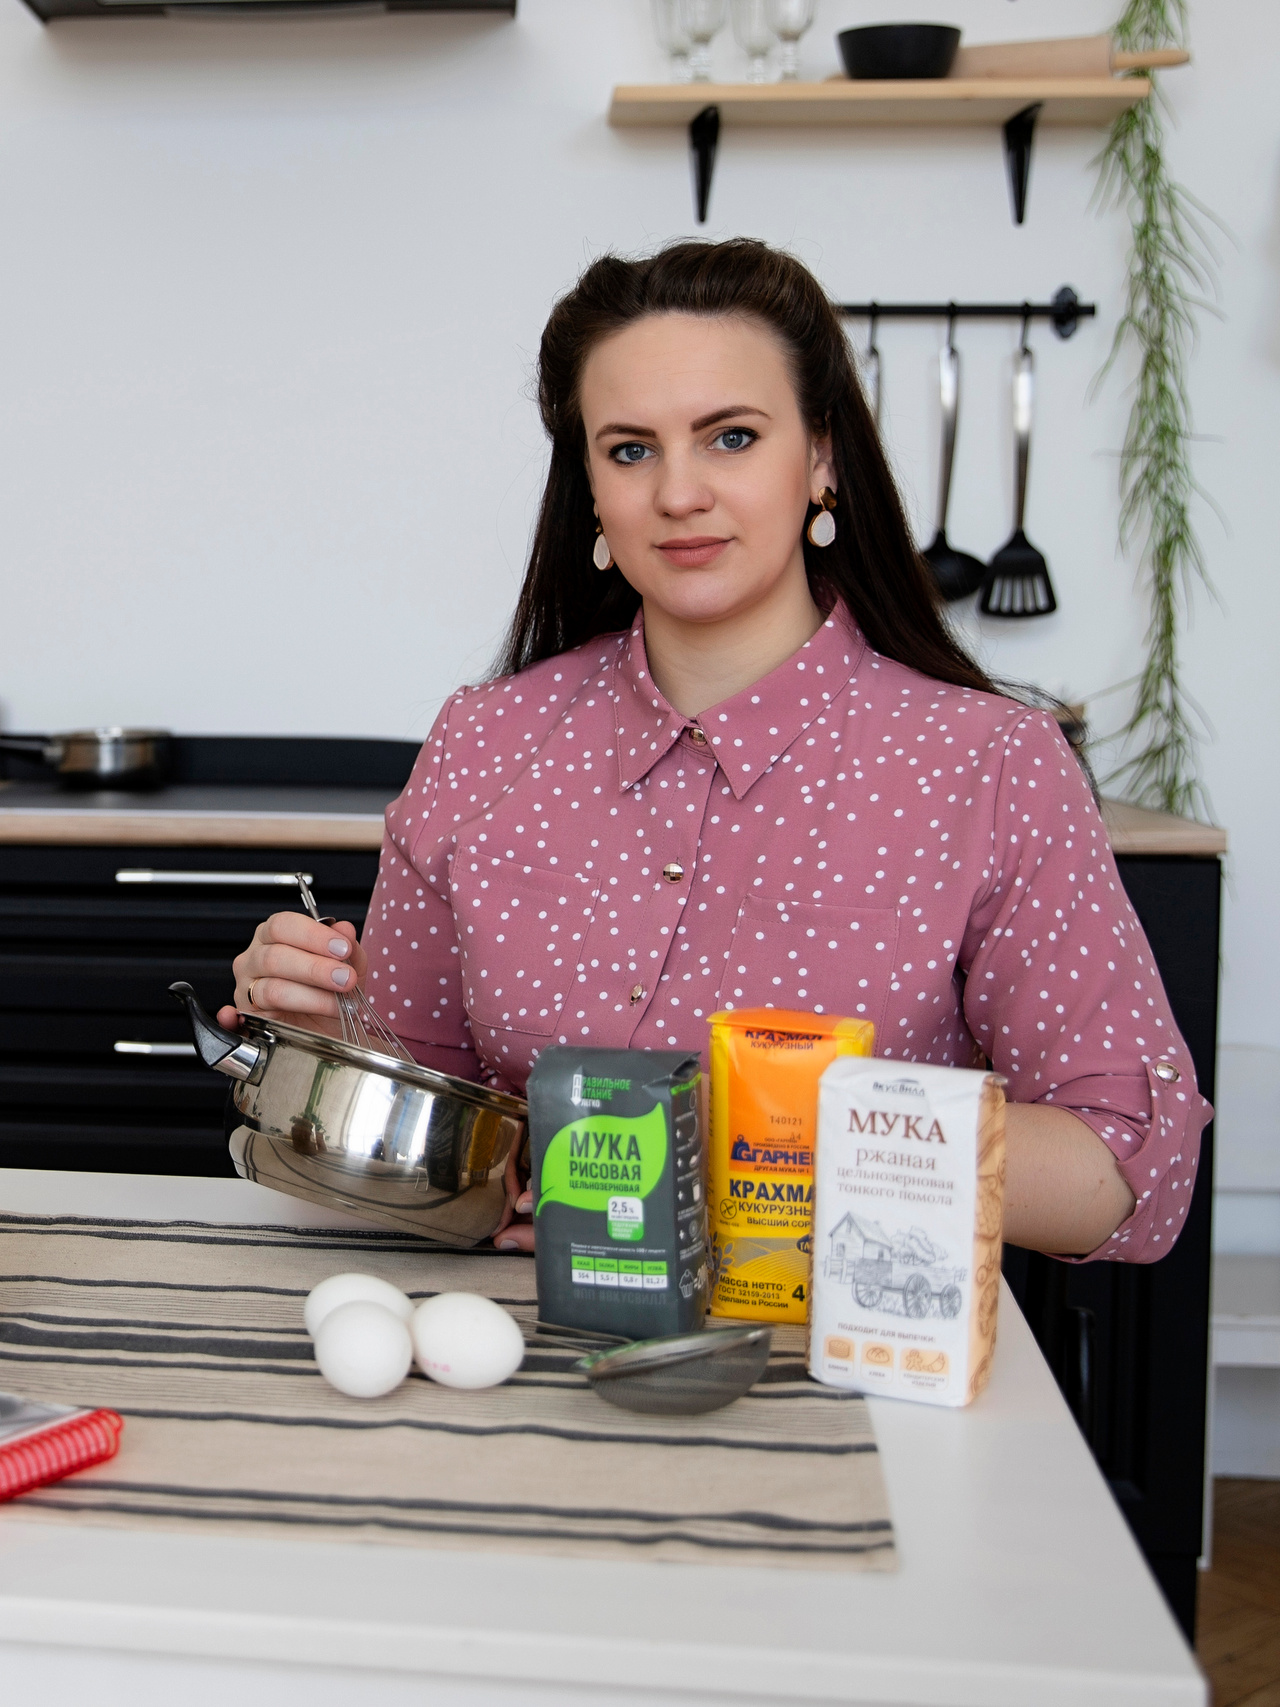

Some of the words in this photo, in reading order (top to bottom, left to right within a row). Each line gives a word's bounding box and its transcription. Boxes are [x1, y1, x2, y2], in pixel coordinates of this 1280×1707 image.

[770, 1115, 803, 1126] 140121
[847, 1108, 947, 1144] МУКА
[570, 1131, 642, 1161] МУКА
[751, 1149, 814, 1166] ГАРНЕ
[856, 1147, 937, 1171] ржаная
[570, 1161, 642, 1181] РИСОВАЯ
[754, 1165, 778, 1173] ДРУГАЯ
[837, 1166, 954, 1190] цельнозерновая
[570, 1180, 640, 1193] ЦЕЛЬНОЗЕРНОВАЯ
[729, 1178, 813, 1203] КРАХМА
[837, 1182, 894, 1198] тонкого
[899, 1191, 952, 1206] помола
[611, 1201, 627, 1215] 2,5
[739, 1201, 811, 1217] КУКУРУЗНЫ
[747, 1216, 789, 1227] ВЫСШИЙ
[791, 1219, 811, 1228] СОР
[718, 1284, 736, 1295] ГОСТ
[720, 1274, 749, 1288] масса
[752, 1280, 787, 1292] нетто:
[718, 1294, 749, 1305] сделано
[758, 1298, 788, 1308] России
[792, 1284, 805, 1302] 4
[837, 1322, 878, 1336] ПОДХОДИТ
[880, 1329, 896, 1339] ДЛЯ
[897, 1331, 936, 1344] ВЫПЕЧКИ:
